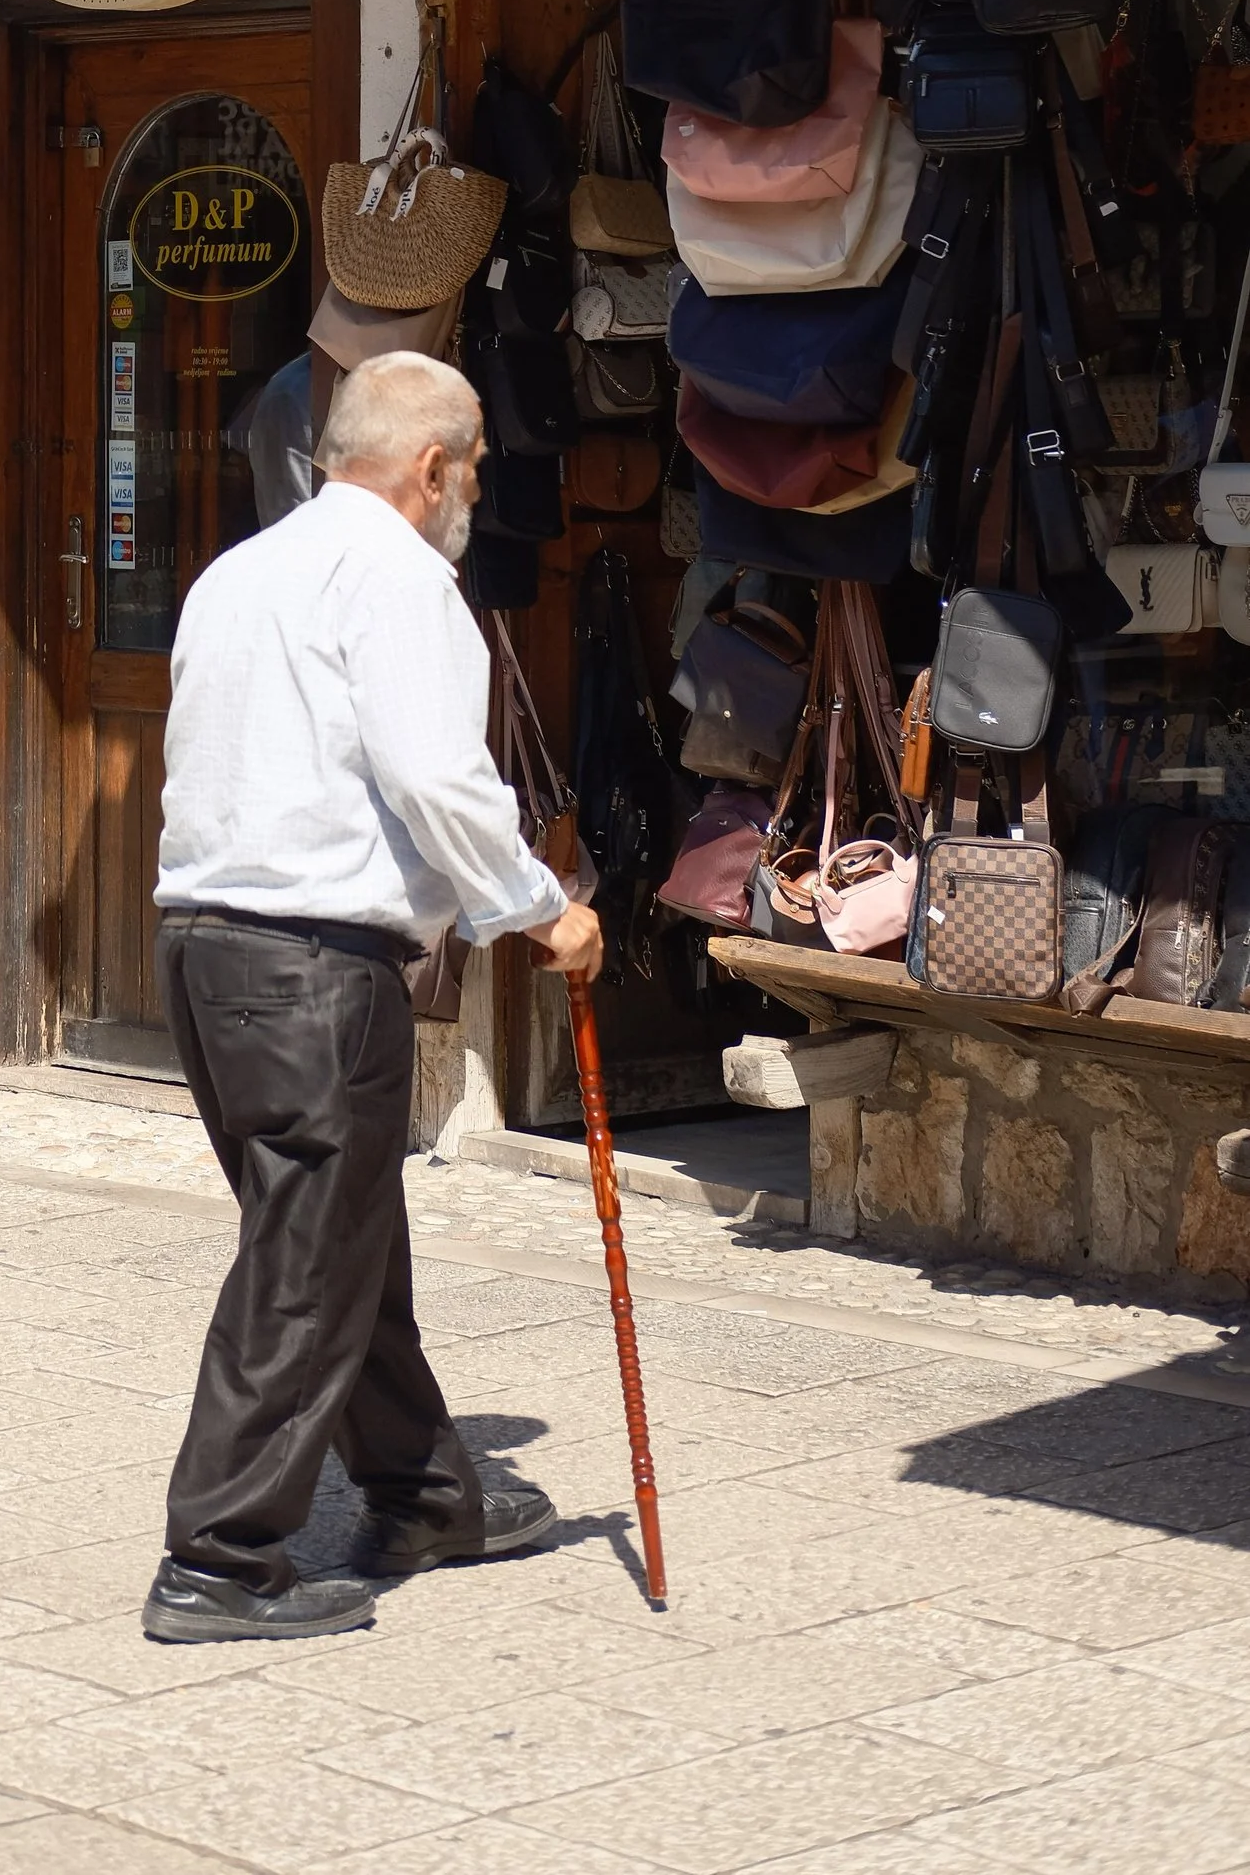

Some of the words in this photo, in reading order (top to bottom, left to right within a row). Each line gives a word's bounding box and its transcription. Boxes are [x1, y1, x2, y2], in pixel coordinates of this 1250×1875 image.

[155, 235, 273, 272] perfumum
[112, 308, 132, 317] ALARM
[117, 397, 131, 405] VISA
[116, 415, 130, 423] VISA
[114, 460, 133, 472] VISA
[114, 488, 133, 500] VISA
